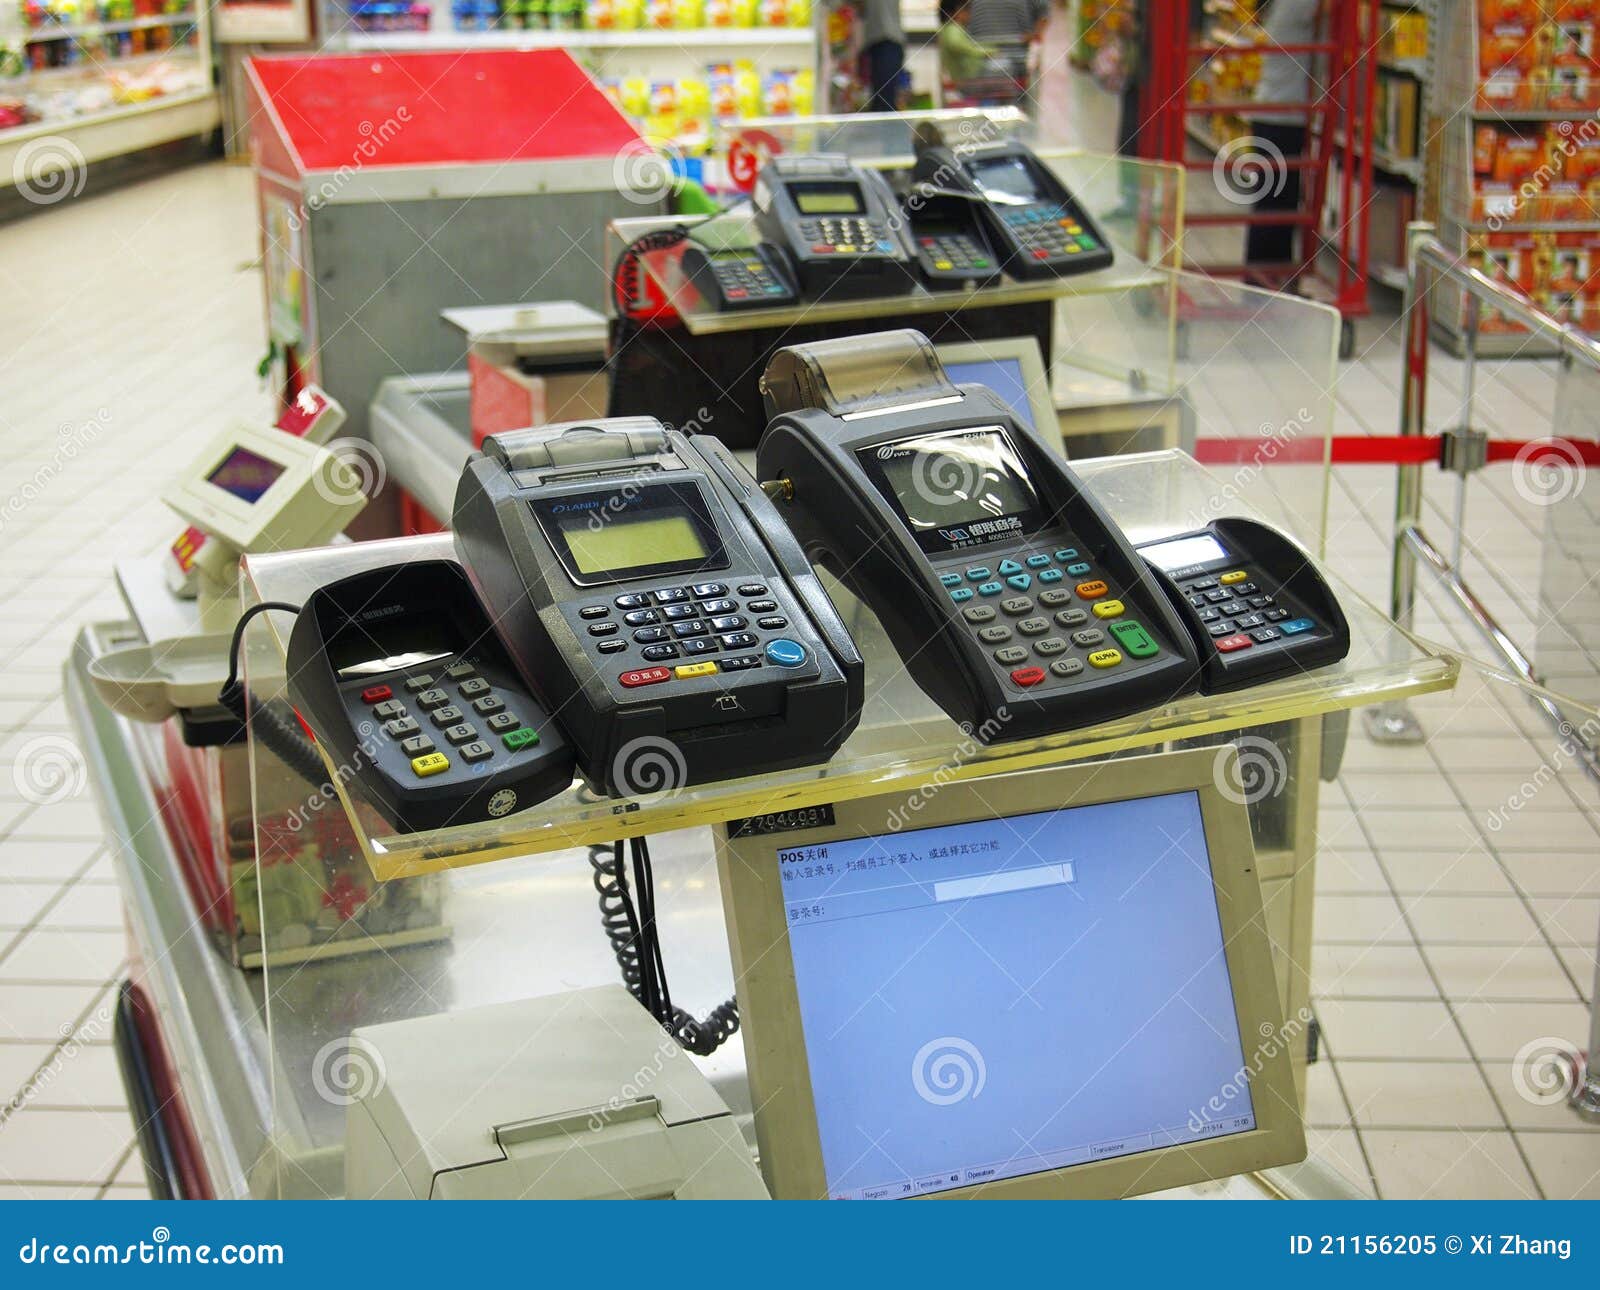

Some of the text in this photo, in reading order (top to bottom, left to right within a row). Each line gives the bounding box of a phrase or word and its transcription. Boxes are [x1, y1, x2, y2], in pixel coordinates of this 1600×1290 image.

[968, 516, 1023, 536] 银联商务
[675, 589, 684, 597] 2
[711, 584, 720, 592] 3
[1082, 583, 1105, 592] CLEAR
[683, 605, 692, 613] 5
[722, 600, 730, 608] 6
[692, 622, 701, 630] 8
[731, 617, 740, 625] 9
[1116, 623, 1139, 633] ENTER
[1094, 651, 1118, 662] ALPHA
[384, 680, 481, 711] 1 2 3
[398, 697, 496, 729] 4 5 6
[410, 715, 510, 748] 7 8 9
[419, 755, 444, 768] 更正
[470, 744, 483, 753] 0
[780, 847, 829, 864] POS关闭
